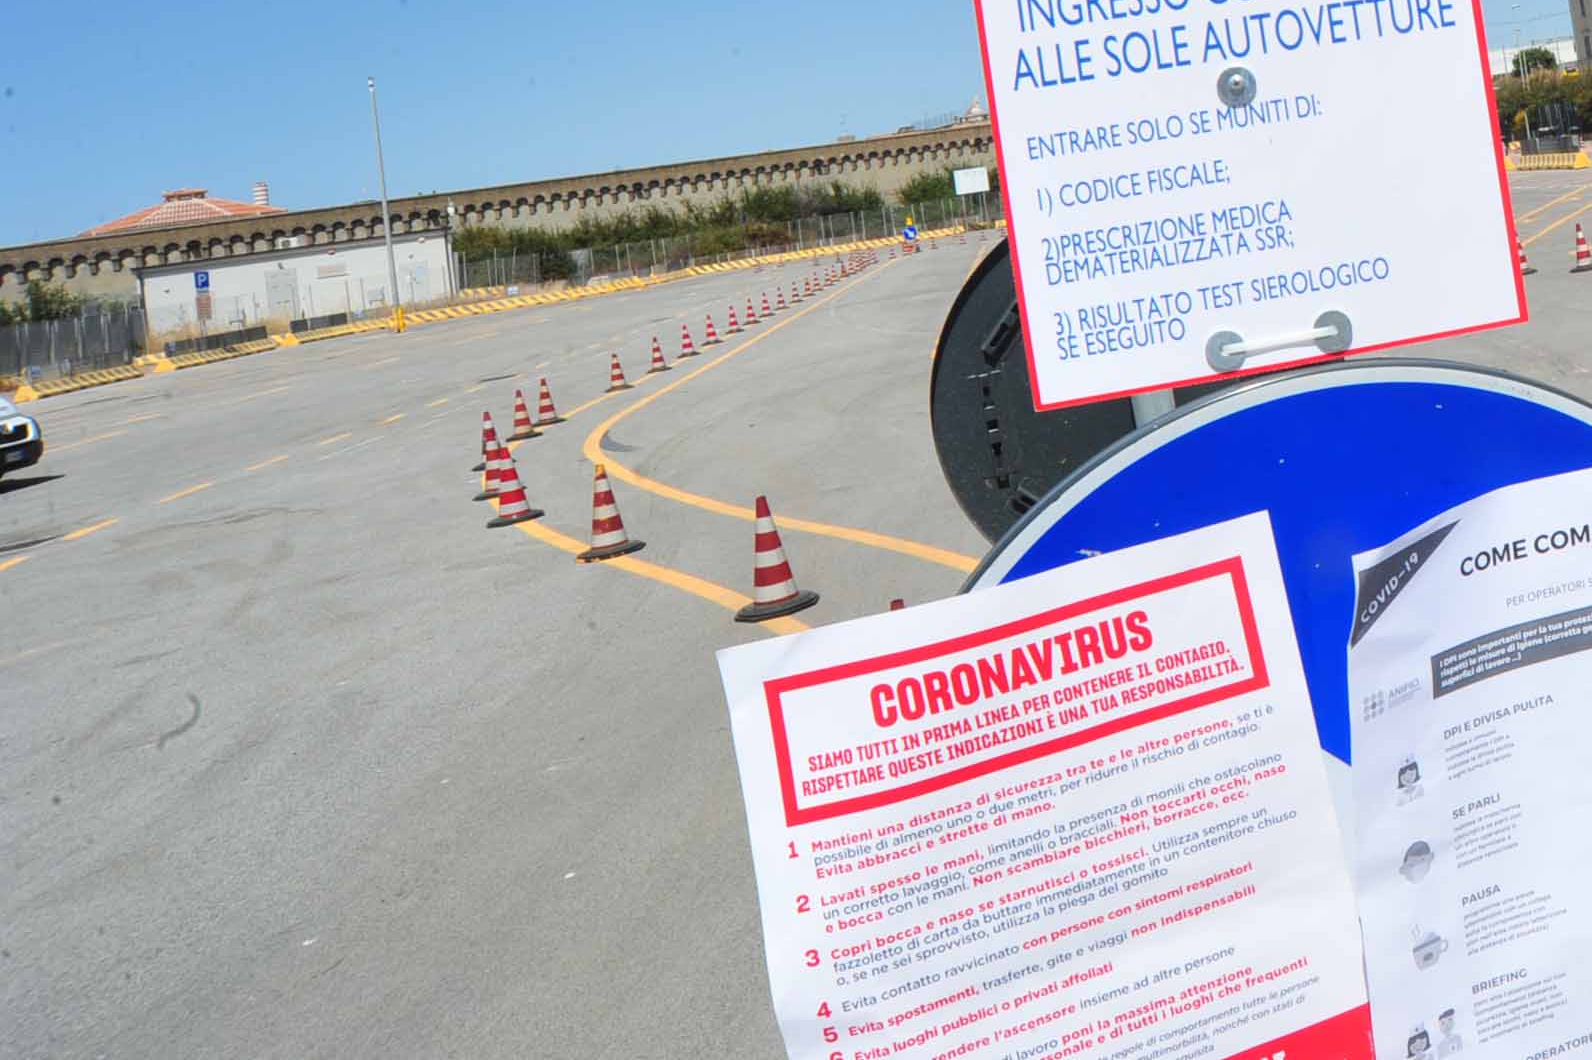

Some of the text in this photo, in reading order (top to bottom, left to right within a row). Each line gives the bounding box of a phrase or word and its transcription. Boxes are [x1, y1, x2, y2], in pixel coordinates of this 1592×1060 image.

[1014, 39, 1095, 91] ALLE
[1103, 25, 1191, 76] SOLE
[1026, 94, 1322, 160] ENTRARE SOLO SE MUNITI DI:
[1059, 172, 1142, 207] CODICE
[1147, 160, 1230, 193] FISCALE;
[1211, 199, 1292, 233] MEDICA
[1045, 226, 1294, 285] DEMATERIALIZZATA SSR;
[1053, 257, 1389, 336] 3) RISULTATO TEST SIEROLOGICO
[1056, 317, 1186, 360] SE ESEGUITO
[1360, 552, 1420, 623] COVID-19
[1460, 539, 1528, 576] COME
[870, 610, 1153, 728] CORONAVIRUS
[802, 655, 1244, 796] RISPETTARE QUESTE INDICAZIONI È UNA TUA RESPONSABILITÀ.
[808, 640, 1230, 772] SIAMO TUTTI IN PRIMA LINEA PER CONTENERE IL CONTAGIO.
[1443, 694, 1554, 740] DPI E DIVISA PULITA
[788, 842, 799, 859] 1
[811, 828, 872, 852] Mantieni
[877, 822, 904, 835] una
[908, 801, 972, 826] distanza
[976, 792, 990, 805] di
[994, 772, 1062, 800] sicurezza
[1065, 765, 1086, 777] tra
[1089, 758, 1104, 769] te
[1108, 754, 1116, 763] e
[1120, 749, 1133, 759] le
[1137, 738, 1169, 754] altre
[1237, 713, 1250, 723] se
[1253, 708, 1262, 718] ti
[1265, 705, 1272, 714] è
[813, 844, 872, 870] possibile
[875, 835, 888, 850] di
[892, 817, 945, 845] almeno
[946, 814, 972, 828] uno
[975, 810, 986, 819] o
[988, 800, 1014, 815] due
[1059, 778, 1082, 795] per
[1084, 763, 1128, 784] ridurre
[1131, 757, 1139, 769] il
[1142, 743, 1184, 764] rischio
[1187, 739, 1199, 751] di
[1452, 792, 1500, 819] SE PARLI
[816, 863, 853, 879] Evita
[857, 842, 922, 869] abbracci
[926, 839, 934, 849] e
[938, 822, 988, 844] strette
[993, 814, 1007, 827] di
[796, 895, 811, 913] 2
[1461, 884, 1501, 906] PAUSA
[805, 950, 821, 967] 3
[816, 860, 1253, 1018] 4 Evita contatto ravvicinato con persone con sintomi respiratori
[823, 1027, 838, 1043] 5
[848, 1021, 884, 1036] Evita
[1046, 952, 1072, 969] gite
[1076, 948, 1084, 956] e
[1087, 930, 1127, 951] viaggi
[1130, 922, 1157, 937] non
[1160, 884, 1256, 926] indispensabili
[1080, 985, 1128, 1009] insieme
[1133, 975, 1149, 990] ad
[1153, 966, 1181, 983] altre
[1184, 947, 1234, 973] persone
[1471, 968, 1527, 994] BRIEFING
[849, 962, 1112, 1060] Evita luoghi pubblici o privati affollati
